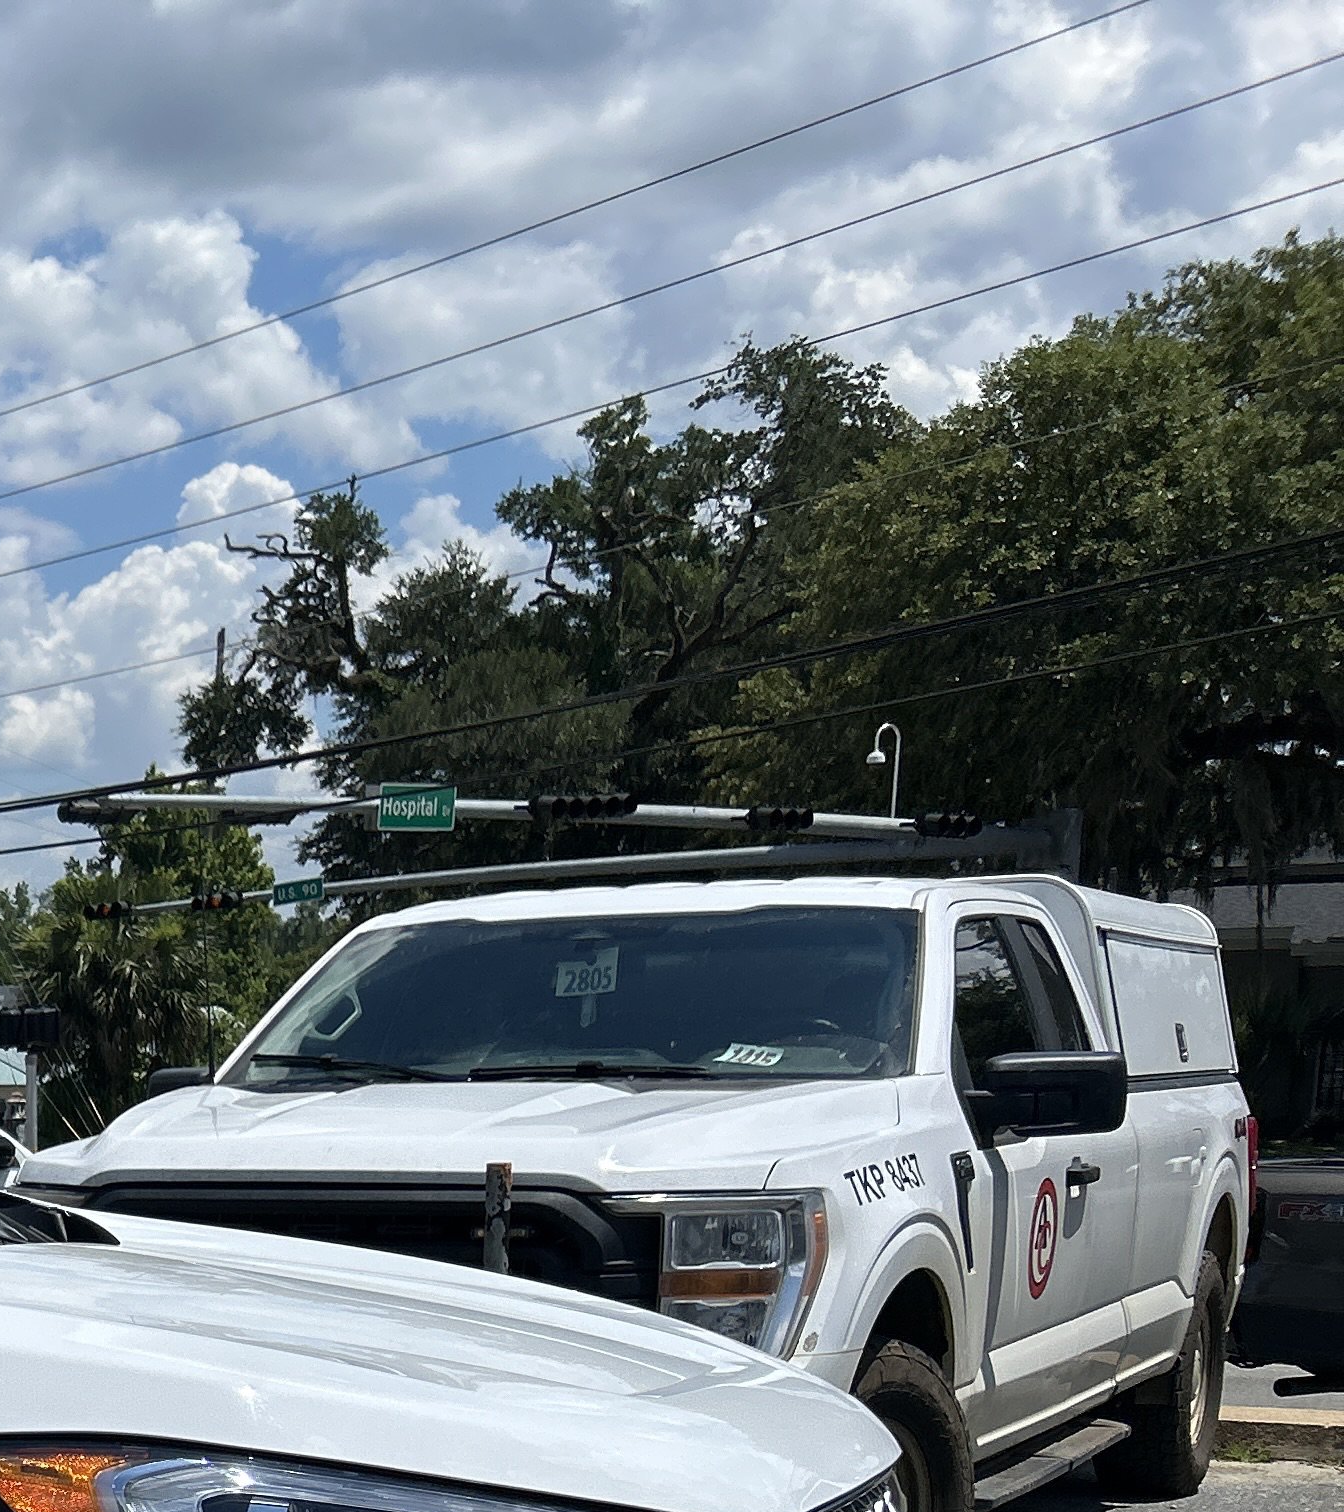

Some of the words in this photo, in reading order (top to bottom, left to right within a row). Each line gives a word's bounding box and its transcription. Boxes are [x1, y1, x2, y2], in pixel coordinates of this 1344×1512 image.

[382, 796, 438, 820] Hospital
[302, 882, 318, 897] 90
[563, 966, 613, 993] 2805
[843, 1170, 886, 1206] TKP
[884, 1152, 926, 1192] 8437
